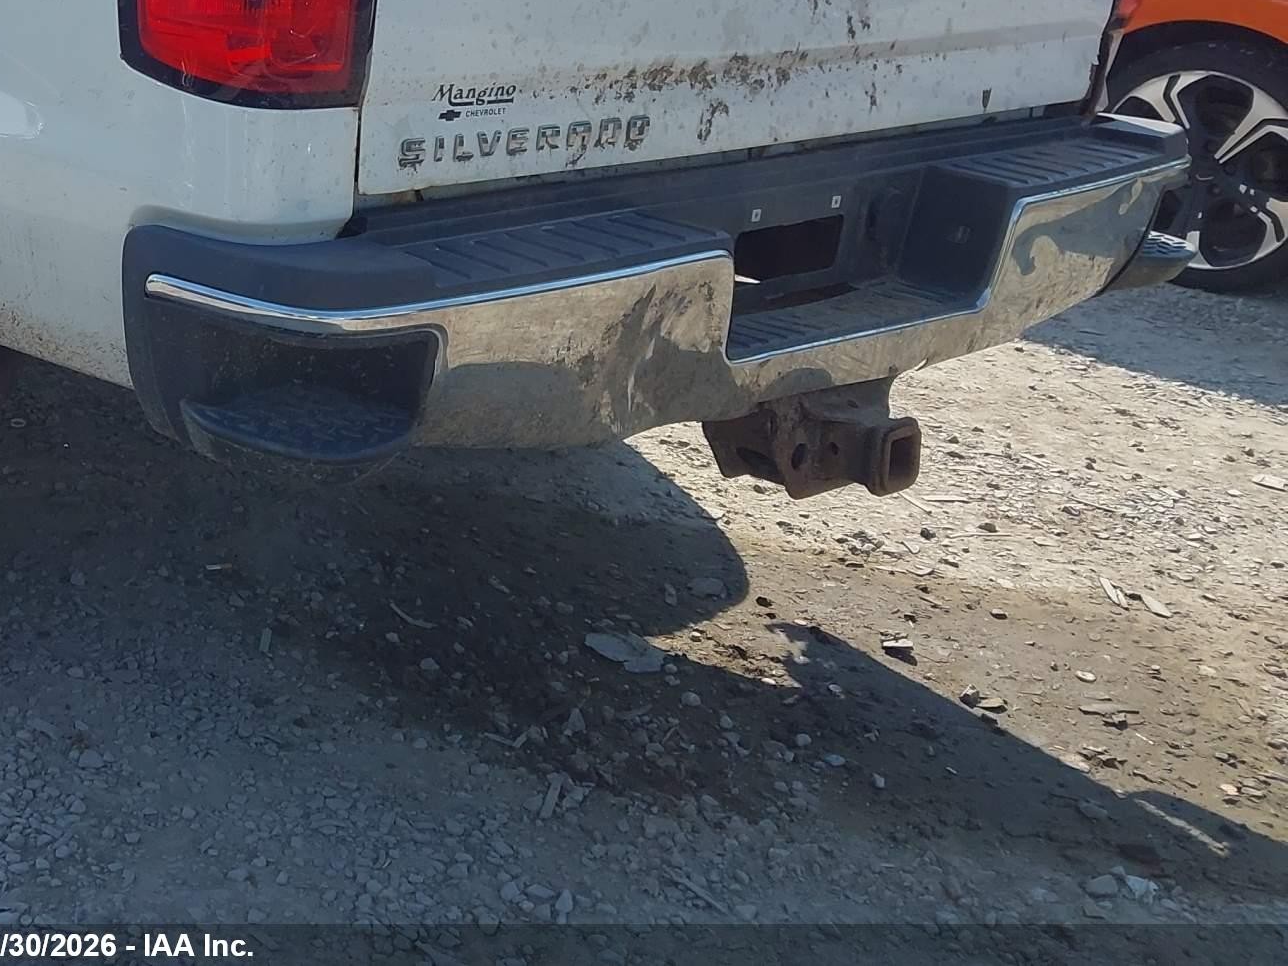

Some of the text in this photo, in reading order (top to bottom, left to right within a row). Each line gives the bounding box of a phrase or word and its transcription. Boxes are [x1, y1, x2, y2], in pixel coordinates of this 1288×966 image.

[432, 83, 517, 107] Mangino
[465, 107, 507, 118] CHEVROLET
[398, 114, 651, 169] SILVERADO
